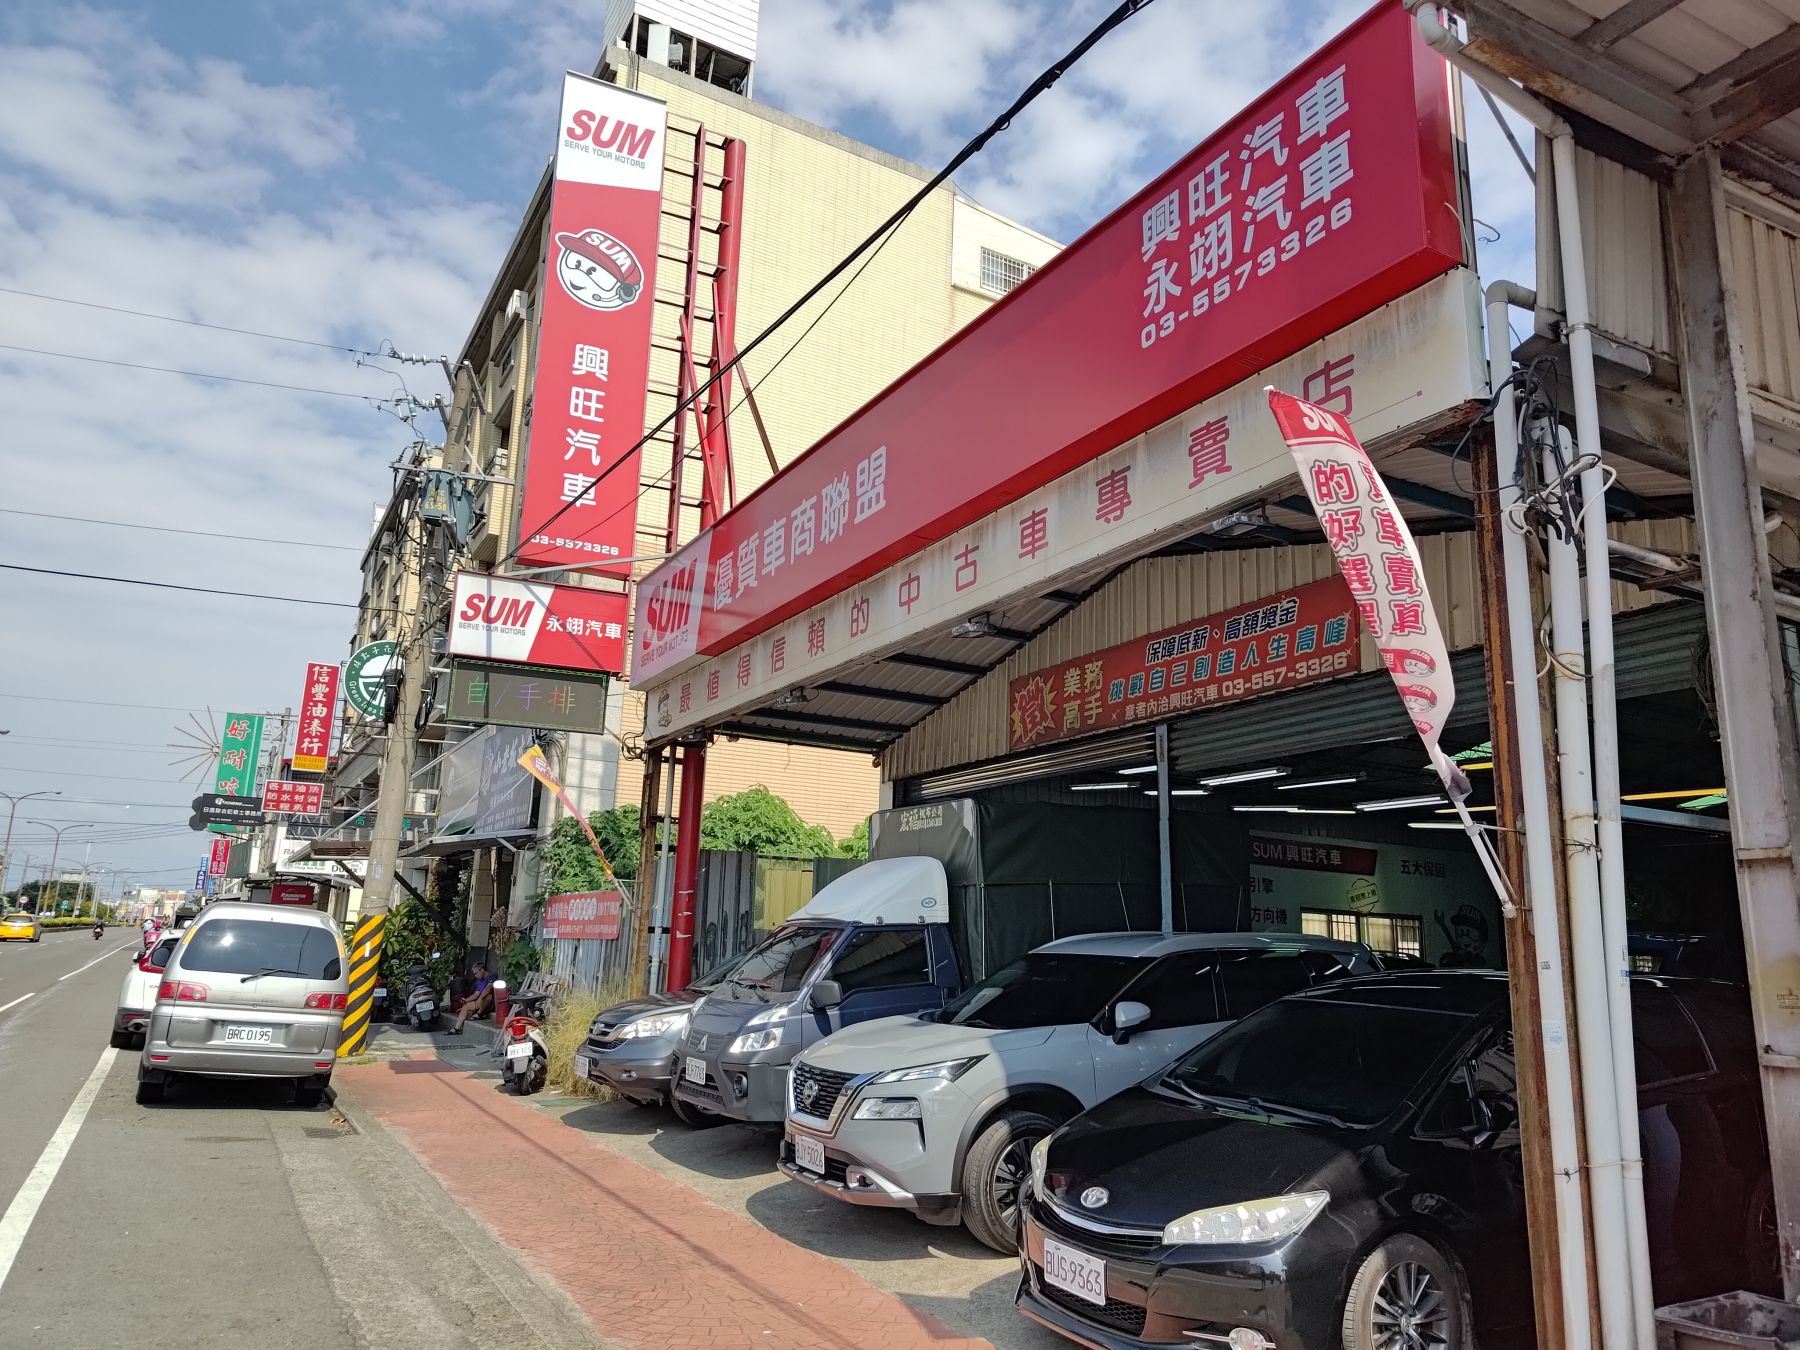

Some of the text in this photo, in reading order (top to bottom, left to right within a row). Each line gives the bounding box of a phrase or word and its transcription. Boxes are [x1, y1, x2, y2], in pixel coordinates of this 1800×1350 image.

[564, 139, 646, 169] SERVE YOUR MOTORS
[566, 109, 655, 160] SUM
[1142, 64, 1349, 262] 興旺汽車
[1142, 129, 1354, 319] 永翊汽車
[585, 232, 631, 273] SUM
[1141, 197, 1352, 349] 03-5573326
[560, 343, 609, 507] 興旺汽車
[712, 445, 887, 613] 優質車商聯盟
[460, 593, 535, 628] SUM
[642, 557, 698, 651] SUM
[458, 621, 526, 637] SERVE YOUR MOTORS
[546, 614, 622, 640] 永翊汽車
[1063, 660, 1103, 698] 業務
[1222, 652, 1348, 698] 03-557-3326
[301, 665, 333, 756] 信豐油漆行
[1063, 690, 1103, 733] 高手
[1252, 841, 1342, 866] SUM 興旺汽車
[1250, 905, 1288, 926] 方向機
